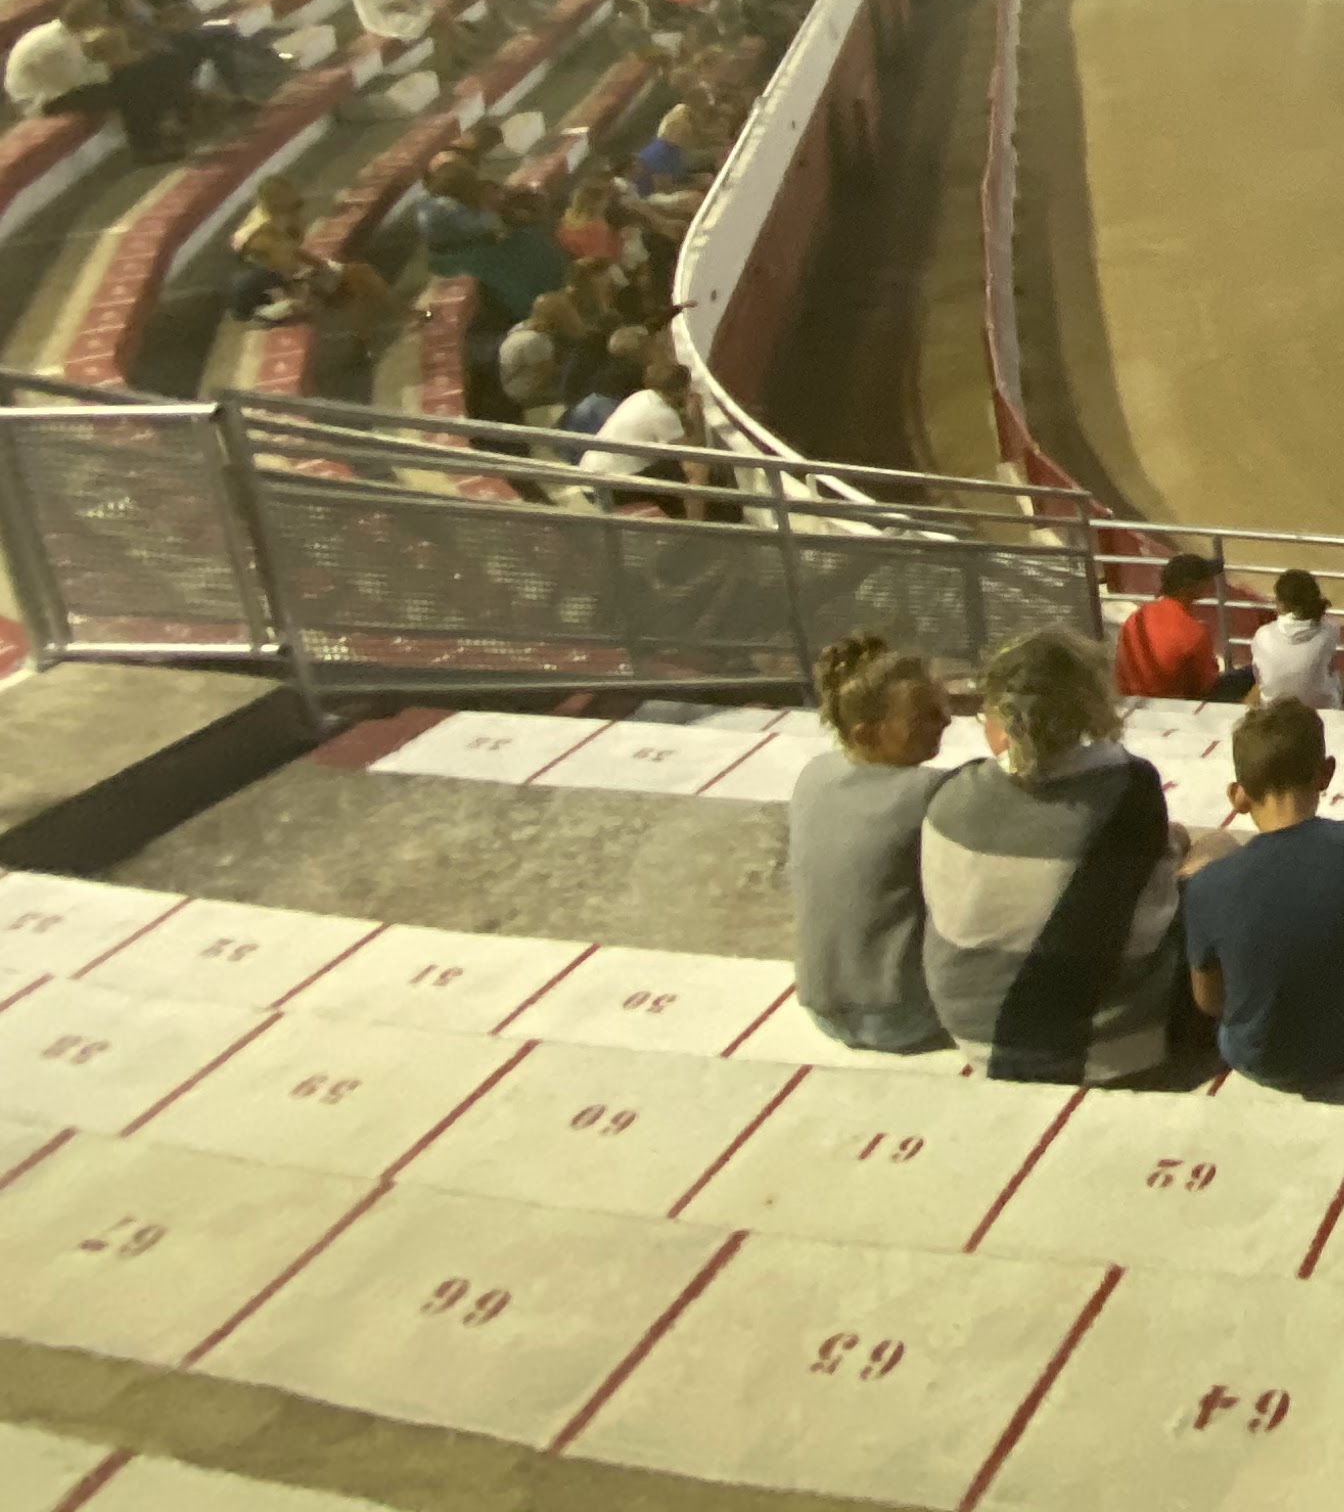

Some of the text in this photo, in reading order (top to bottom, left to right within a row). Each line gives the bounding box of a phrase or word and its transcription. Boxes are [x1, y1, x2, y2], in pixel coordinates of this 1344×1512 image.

[409, 963, 464, 987] 51
[621, 990, 678, 1015] 50
[290, 1074, 363, 1106] 59
[569, 1104, 638, 1135] 60
[857, 1132, 925, 1162] 61
[1146, 1158, 1217, 1192] 62
[77, 1215, 168, 1258] 67
[421, 1277, 512, 1326] 66
[809, 1332, 906, 1381] 65
[1193, 1384, 1291, 1434] 64
